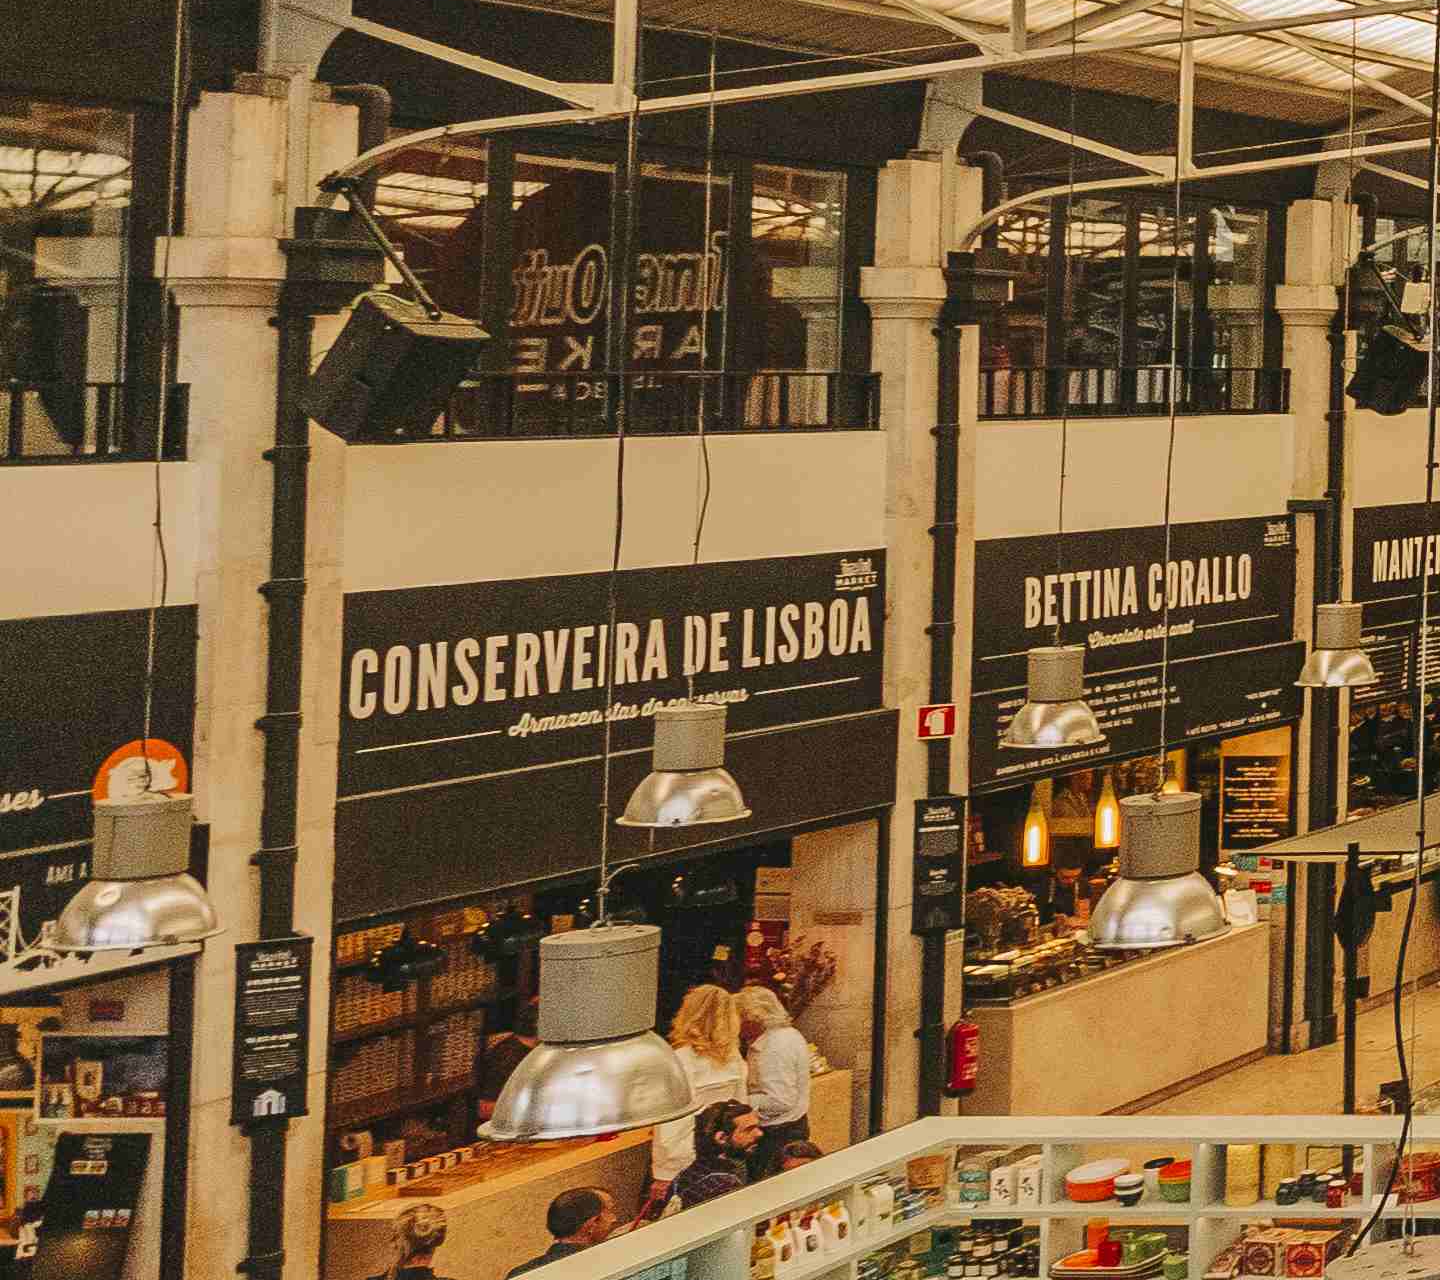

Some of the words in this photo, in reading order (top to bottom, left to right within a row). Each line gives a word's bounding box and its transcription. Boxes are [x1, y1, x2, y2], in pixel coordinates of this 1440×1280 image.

[1024, 565, 1138, 629] BETTINA
[1147, 553, 1252, 612] CORALLO
[348, 618, 669, 721] CONSERVEIRA
[682, 609, 731, 678] DE
[741, 596, 872, 669] LISBOA
